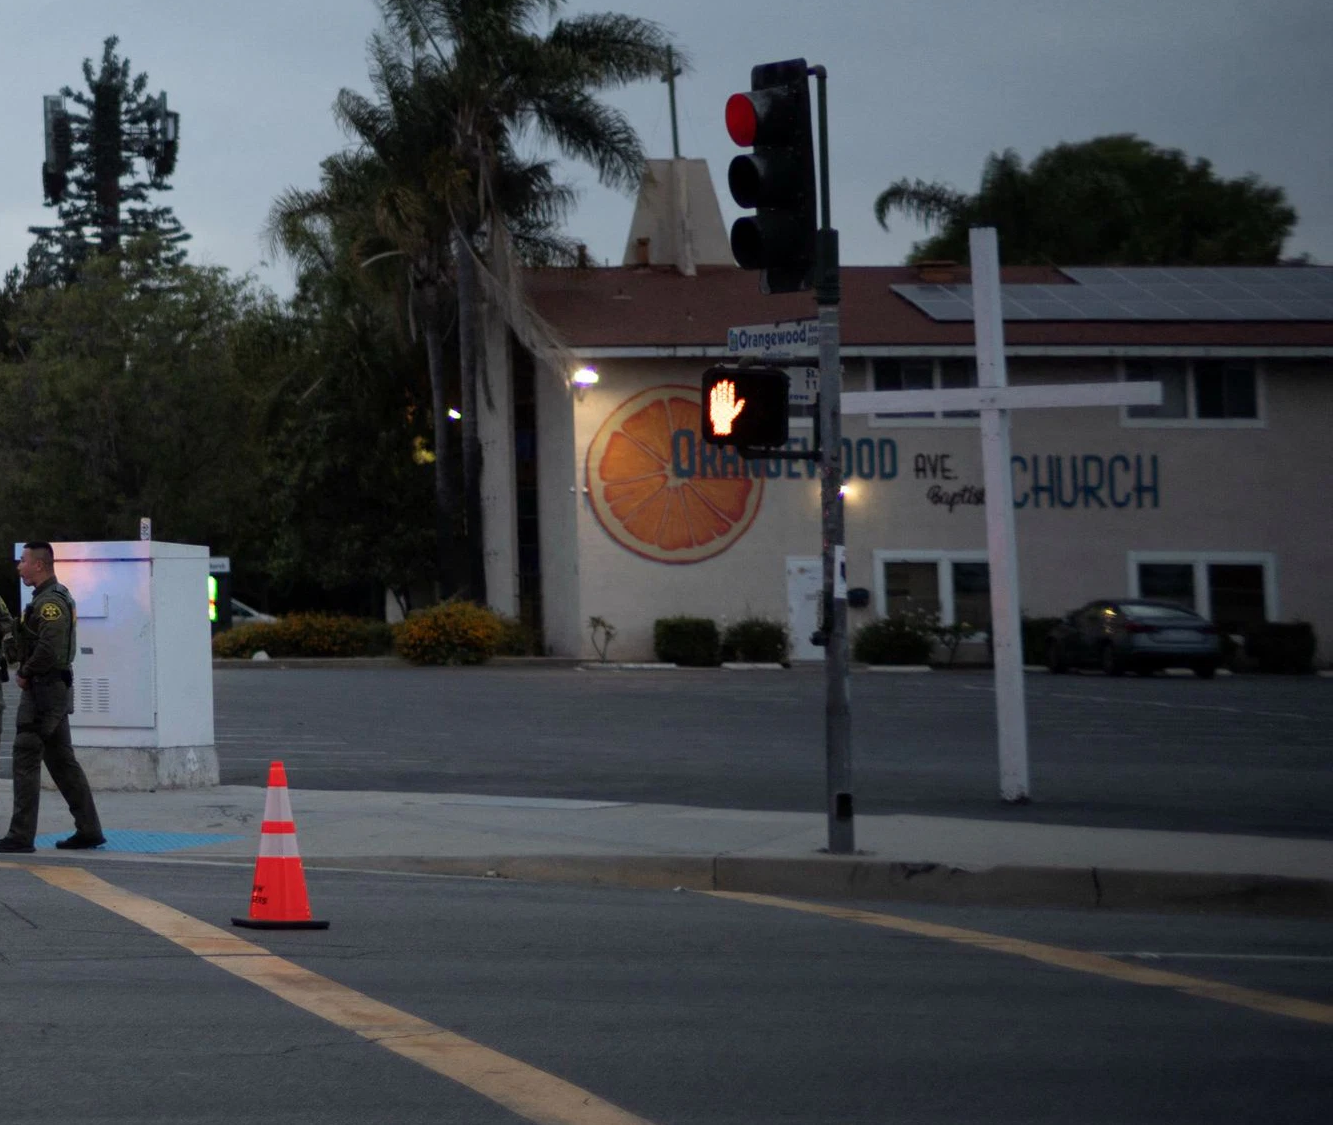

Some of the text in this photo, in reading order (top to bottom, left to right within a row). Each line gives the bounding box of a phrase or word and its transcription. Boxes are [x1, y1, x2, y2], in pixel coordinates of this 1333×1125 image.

[739, 324, 806, 350] Orangewood
[913, 452, 959, 480] AVE.
[1010, 453, 1161, 510] CHURCH
[925, 484, 986, 513] Baptis
